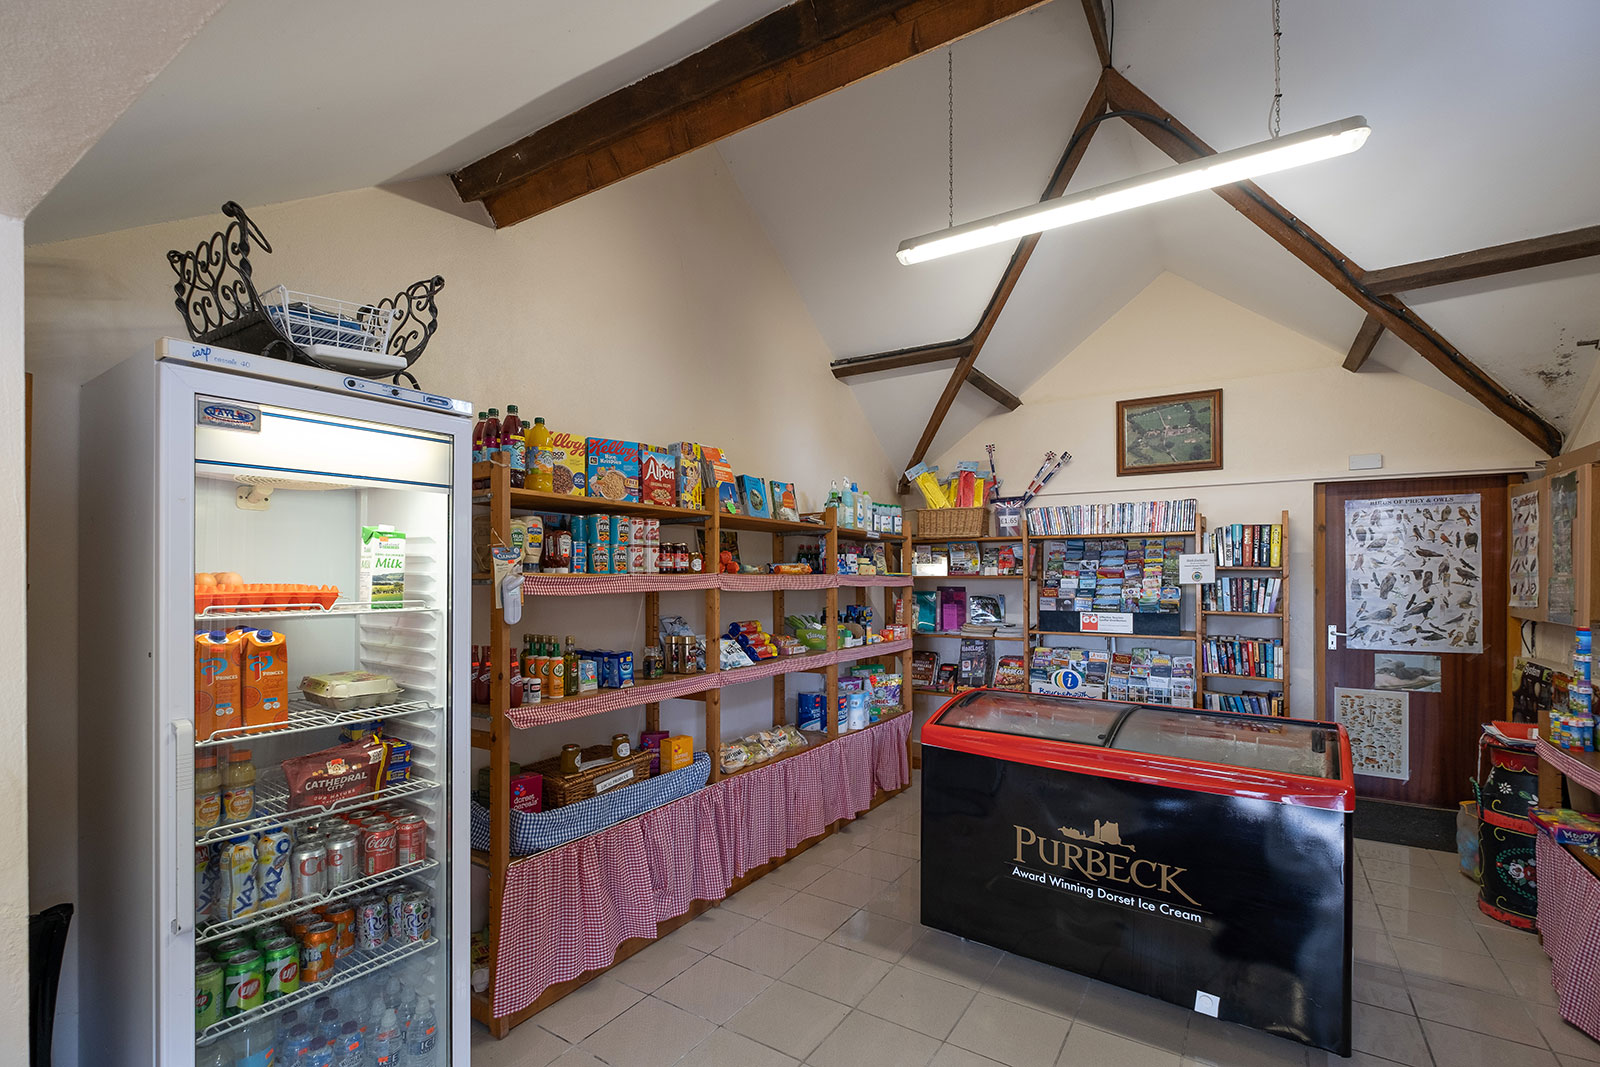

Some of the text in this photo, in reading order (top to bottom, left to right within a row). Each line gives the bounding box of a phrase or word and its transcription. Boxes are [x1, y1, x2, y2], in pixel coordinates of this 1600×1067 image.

[192, 346, 211, 361] iarp
[549, 431, 585, 457] llogg
[645, 459, 675, 482] Alpen
[375, 557, 403, 569] Milk
[1083, 616, 1098, 624] GO
[305, 772, 368, 791] CATHEDRAL
[327, 783, 344, 792] CITY
[1012, 824, 1202, 906] PURBECK
[1012, 866, 1202, 923] Award Winning Dorset Ice Cream
